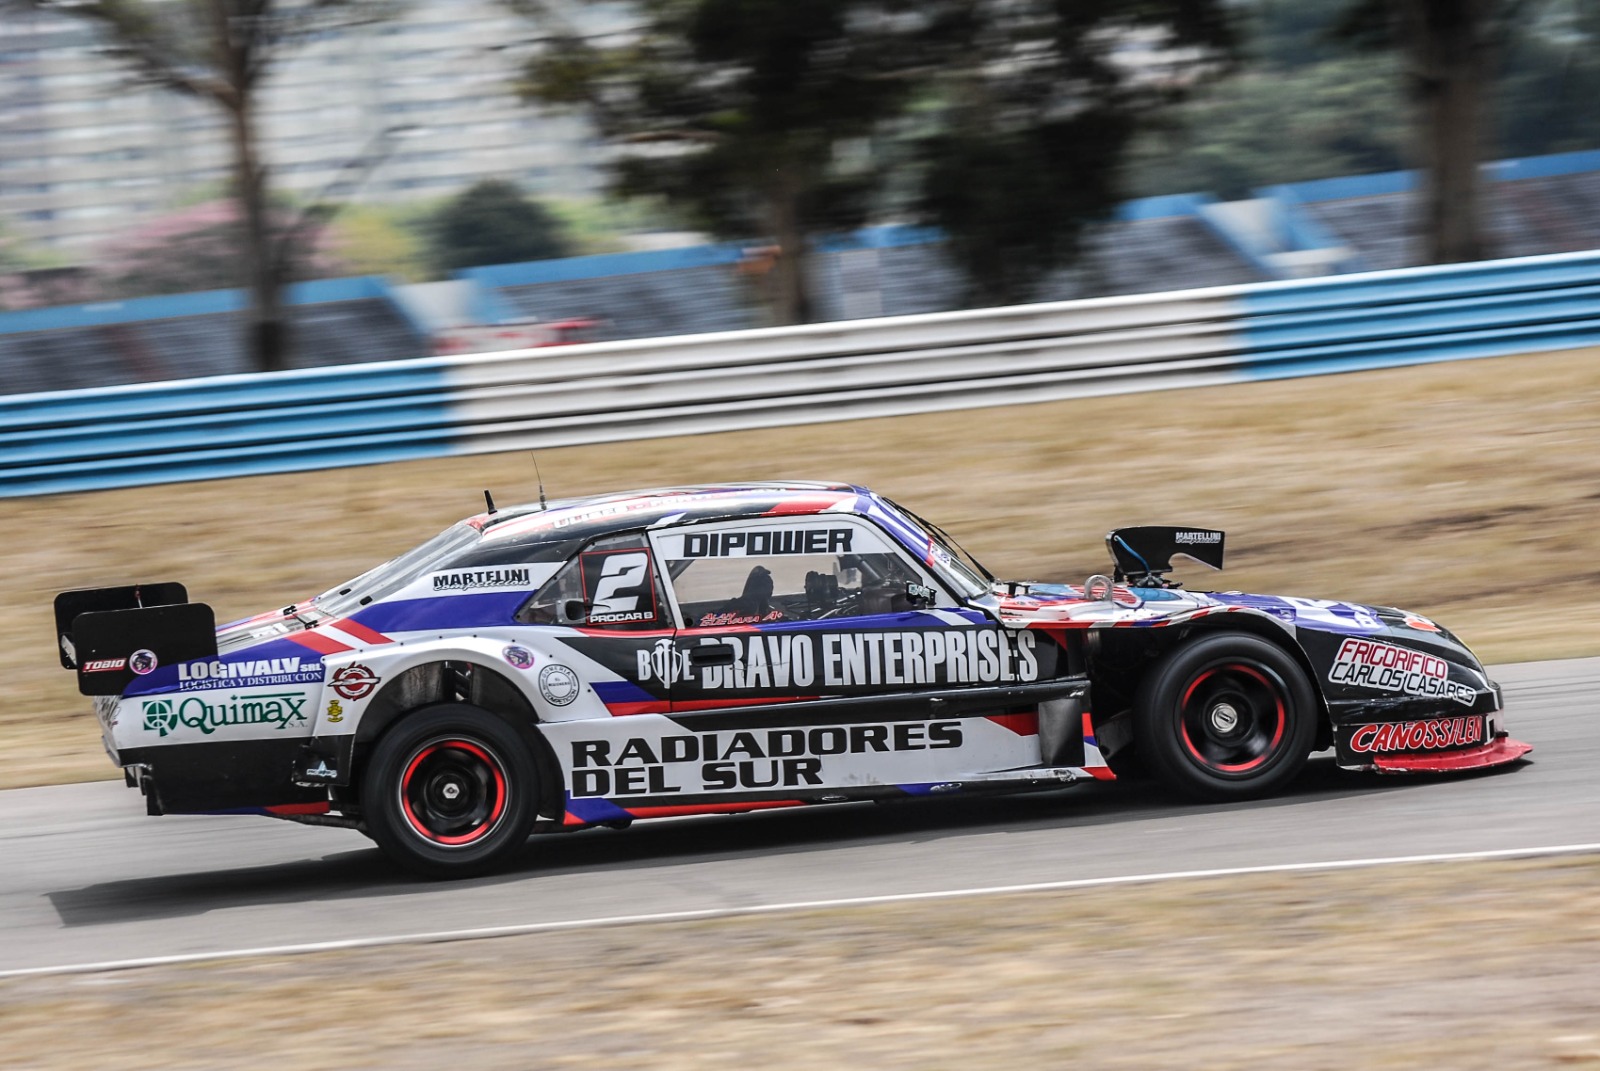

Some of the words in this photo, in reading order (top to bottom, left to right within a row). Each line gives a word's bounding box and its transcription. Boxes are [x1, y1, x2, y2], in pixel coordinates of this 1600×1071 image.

[683, 528, 853, 558] DIPOWER
[590, 552, 648, 616] 2
[590, 612, 643, 623] PROCAR
[643, 611, 654, 620] B
[84, 659, 126, 671] TOBIO
[178, 656, 301, 681] LOGIVALV
[300, 662, 322, 673] SRL
[822, 629, 1039, 686] ENTERPRISES
[1337, 640, 1447, 679] FRIGORIFICO
[179, 679, 233, 691] LOGISTICA
[239, 677, 247, 687] Y
[247, 672, 323, 686] DISTRIBUCION
[1331, 662, 1404, 688] CARLOS
[1406, 673, 1475, 704] CASARES
[571, 721, 963, 768] RADIADORES
[571, 766, 682, 798] DEL
[702, 757, 824, 791] SUR
